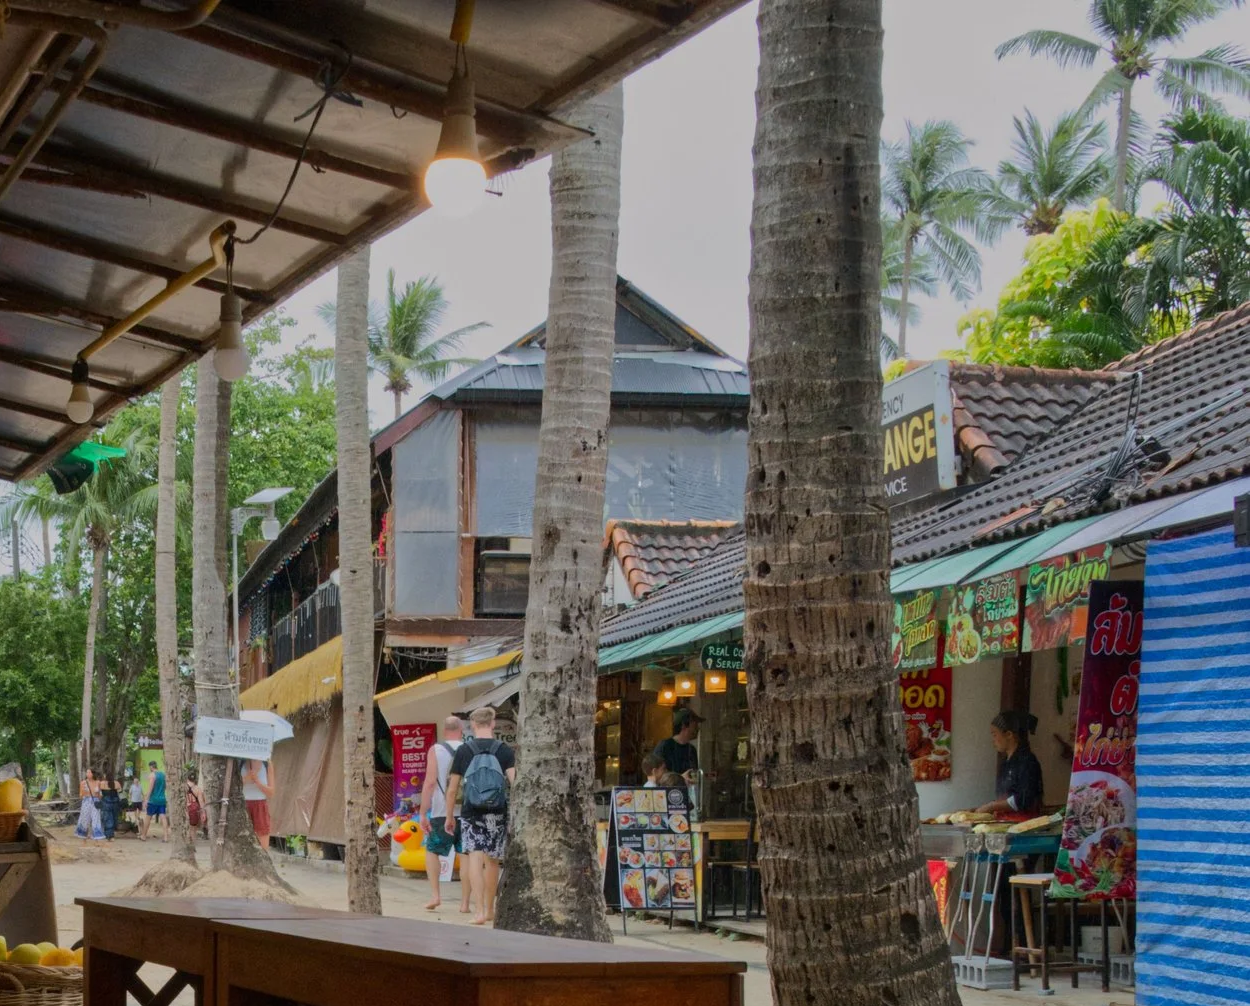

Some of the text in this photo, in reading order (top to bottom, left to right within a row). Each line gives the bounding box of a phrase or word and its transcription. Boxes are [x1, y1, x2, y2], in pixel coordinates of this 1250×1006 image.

[884, 410, 936, 475] ANGE
[884, 476, 908, 498] VICE
[708, 645, 730, 657] REAL
[393, 728, 410, 736] true
[402, 736, 425, 750] 5G
[402, 752, 426, 762] BEST
